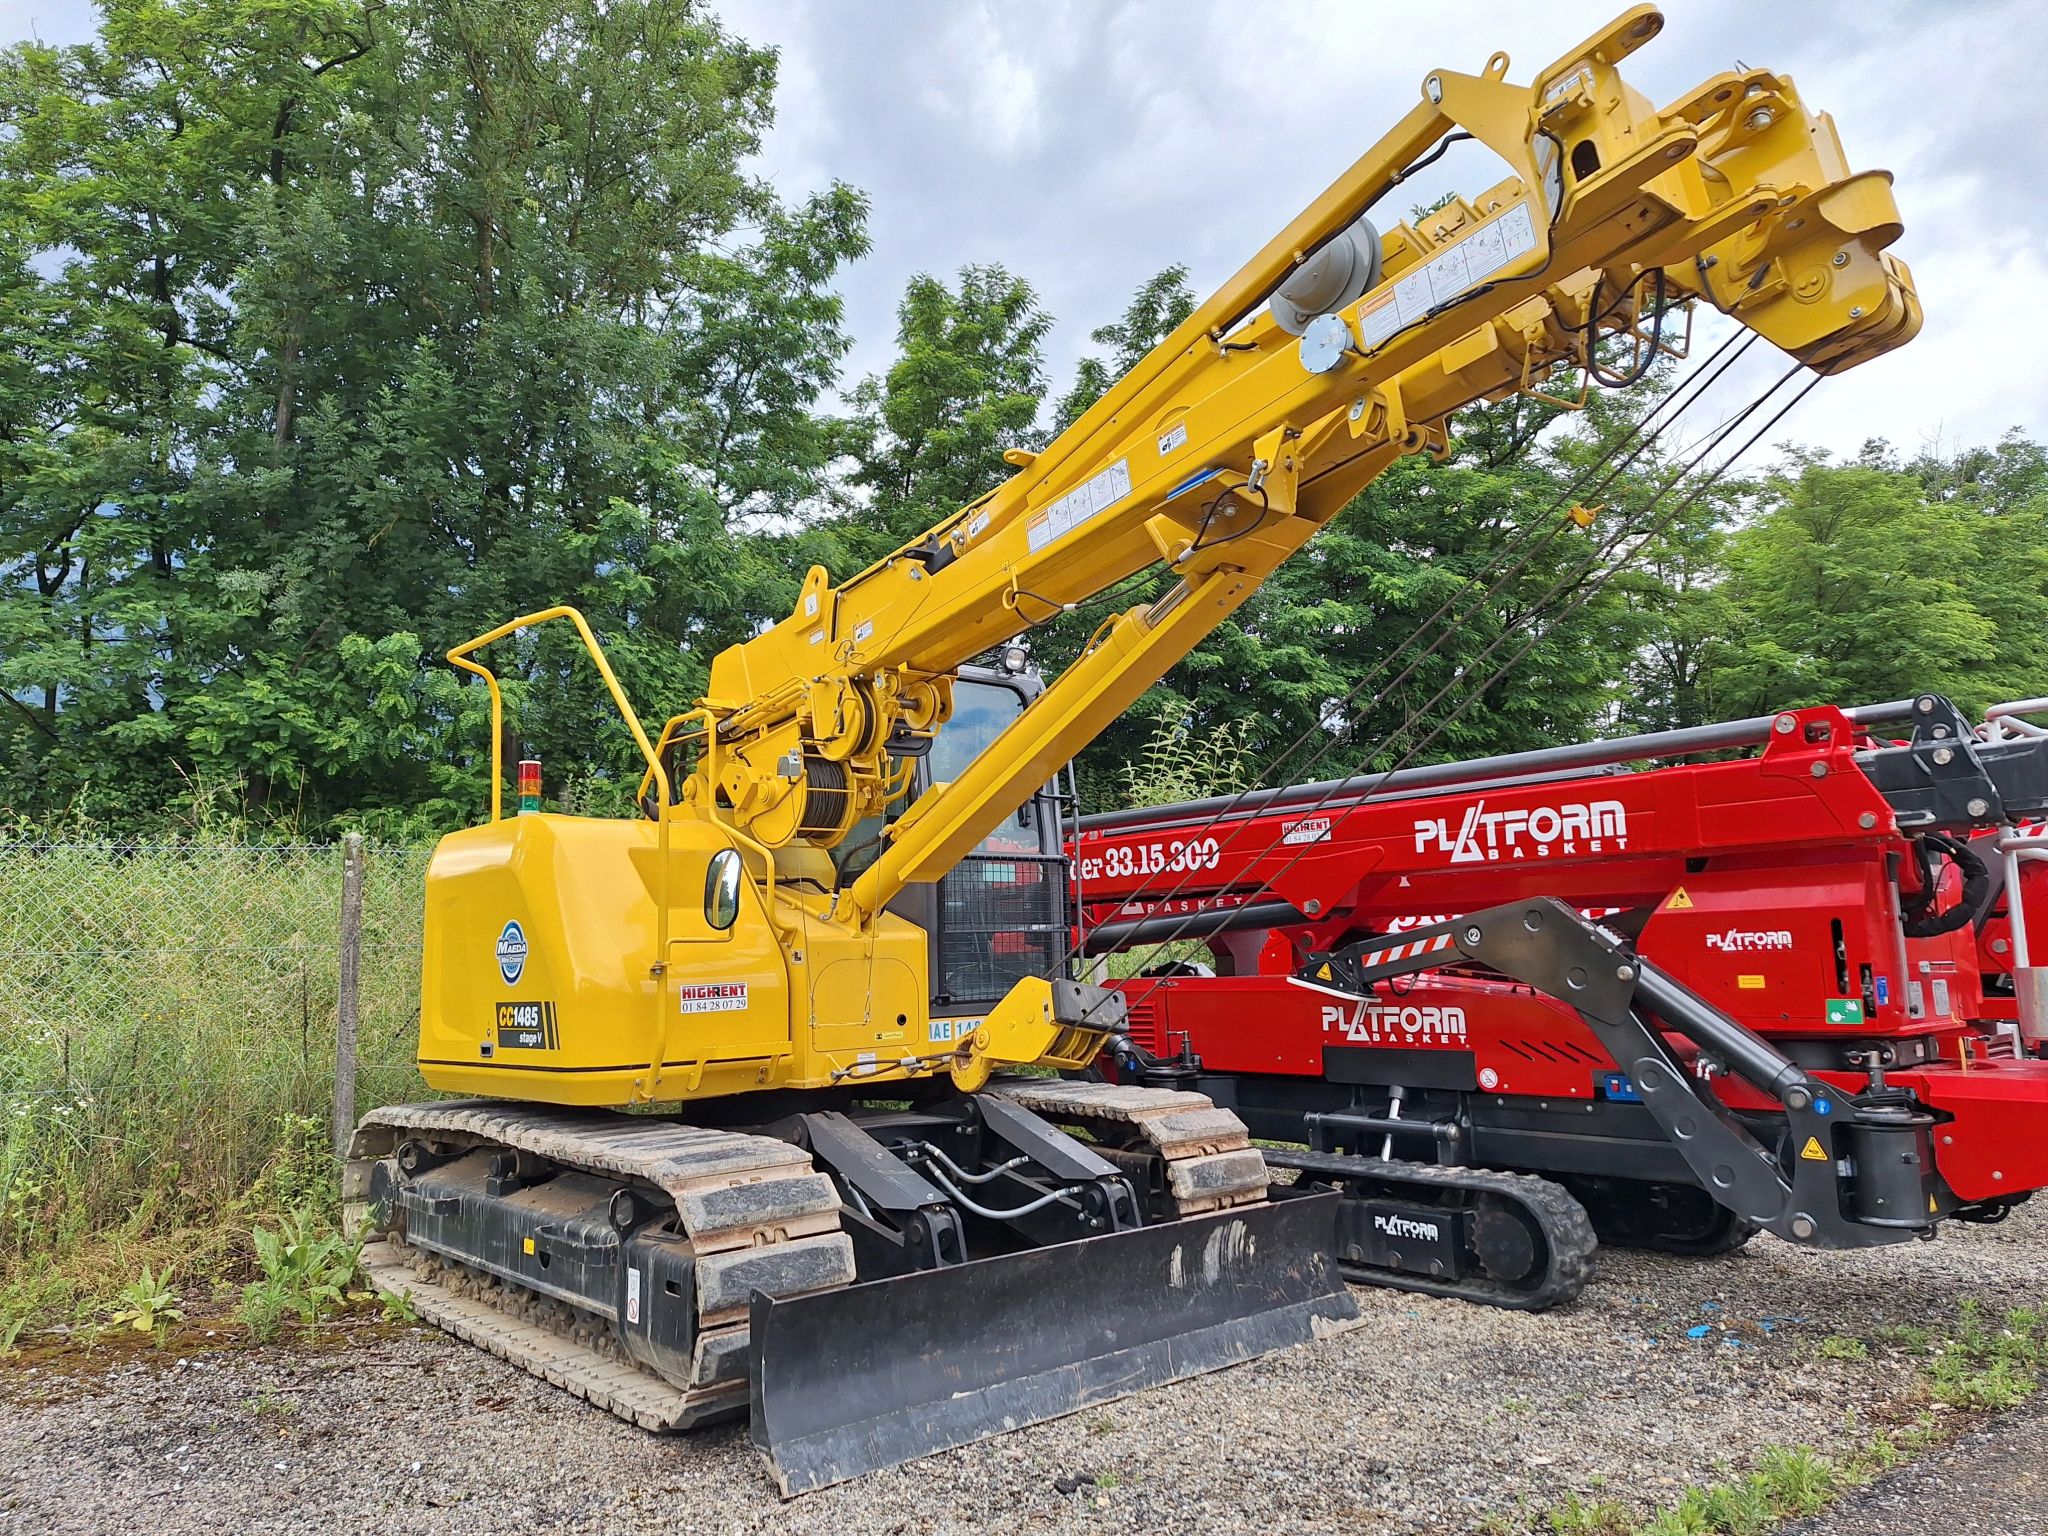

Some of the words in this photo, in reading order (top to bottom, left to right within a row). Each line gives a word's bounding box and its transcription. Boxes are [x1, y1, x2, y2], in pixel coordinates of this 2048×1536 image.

[1414, 799, 1627, 863] PLATFORM
[1105, 837, 1220, 878] 33.15.300
[1488, 837, 1627, 860] BASKET
[497, 940, 526, 955] MAEDA
[1706, 928, 1793, 951] PLATFORM
[682, 985, 746, 1000] HIGHRENT
[500, 1006, 538, 1027] CC1485
[682, 1003, 693, 1012] 01
[697, 1002, 707, 1011] 84
[710, 1001, 721, 1010] 28
[723, 1000, 733, 1009] 07
[736, 999, 746, 1008] 29
[1321, 1000, 1466, 1041] PLATFORM
[519, 1032, 536, 1046] stage
[536, 1032, 542, 1043] V
[1372, 1033, 1467, 1045] BASKET
[1374, 1214, 1439, 1238] PLATFORM
